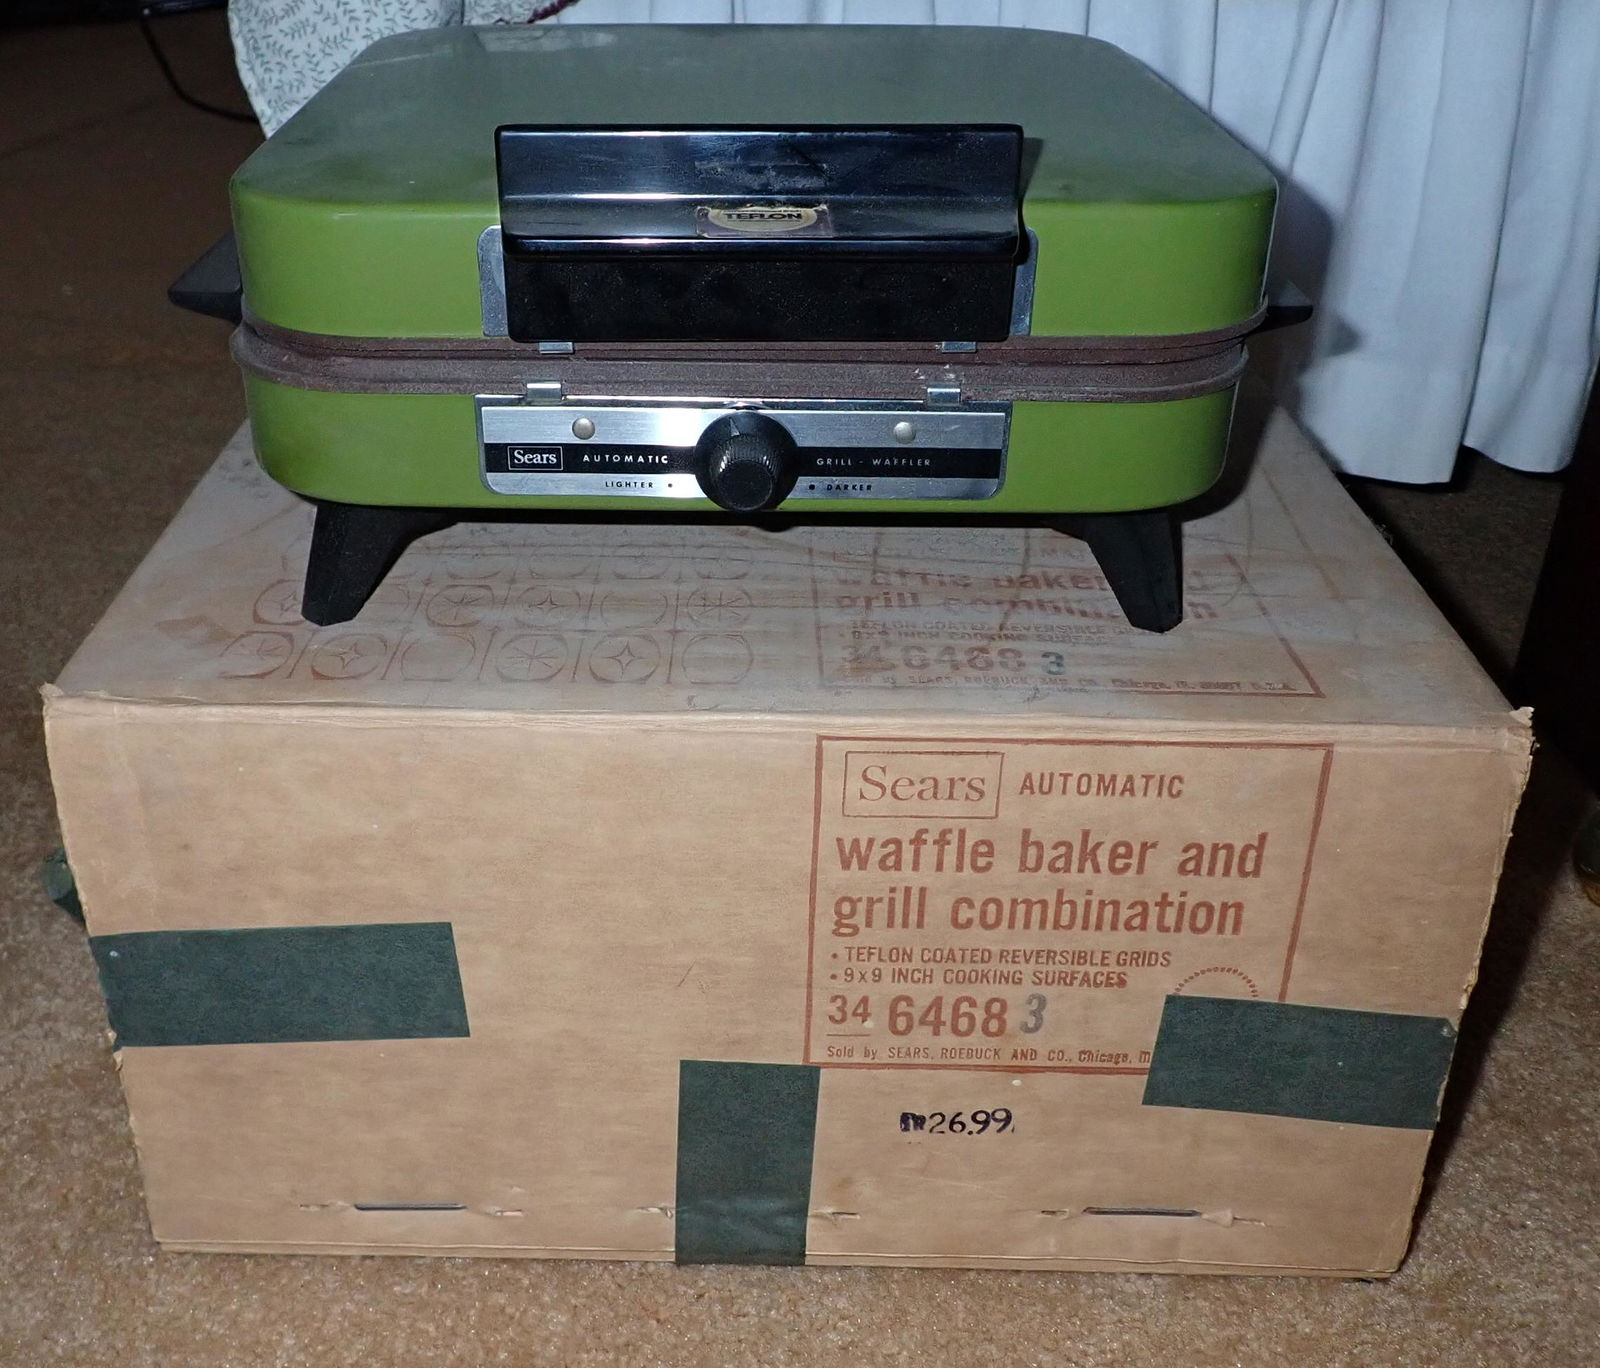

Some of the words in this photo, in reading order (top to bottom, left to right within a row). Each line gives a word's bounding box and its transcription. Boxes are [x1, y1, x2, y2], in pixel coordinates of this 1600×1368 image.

[513, 449, 558, 465] Sears
[582, 454, 669, 464] AUTOMATIC
[816, 457, 853, 467] GRILL
[872, 457, 932, 467] WAFFLER
[605, 480, 654, 489] LIGHTER
[826, 483, 873, 492] DARKER
[1040, 651, 1067, 676] 3
[858, 764, 987, 802] Sears
[1018, 771, 1186, 800] AUTOMATIC
[835, 827, 996, 873] waffle
[1017, 827, 1160, 876] baker
[1176, 831, 1269, 878] and
[831, 886, 928, 938] grill
[950, 888, 1245, 936] combination
[844, 946, 914, 964] TEFLON
[920, 947, 993, 965] COATED
[998, 948, 1112, 967] REVERSIBLE
[1116, 950, 1173, 968] GRIDS
[891, 967, 934, 985] INCH
[943, 968, 1024, 986] COOKING
[1031, 969, 1128, 989] SURFACES
[827, 994, 872, 1025] 34
[887, 994, 1008, 1038] 6468
[1019, 992, 1048, 1035] 3
[827, 1046, 855, 1059] Sold
[863, 1047, 878, 1060] by
[940, 1047, 1002, 1061] ROEBUCK
[1010, 1048, 1038, 1062] AND
